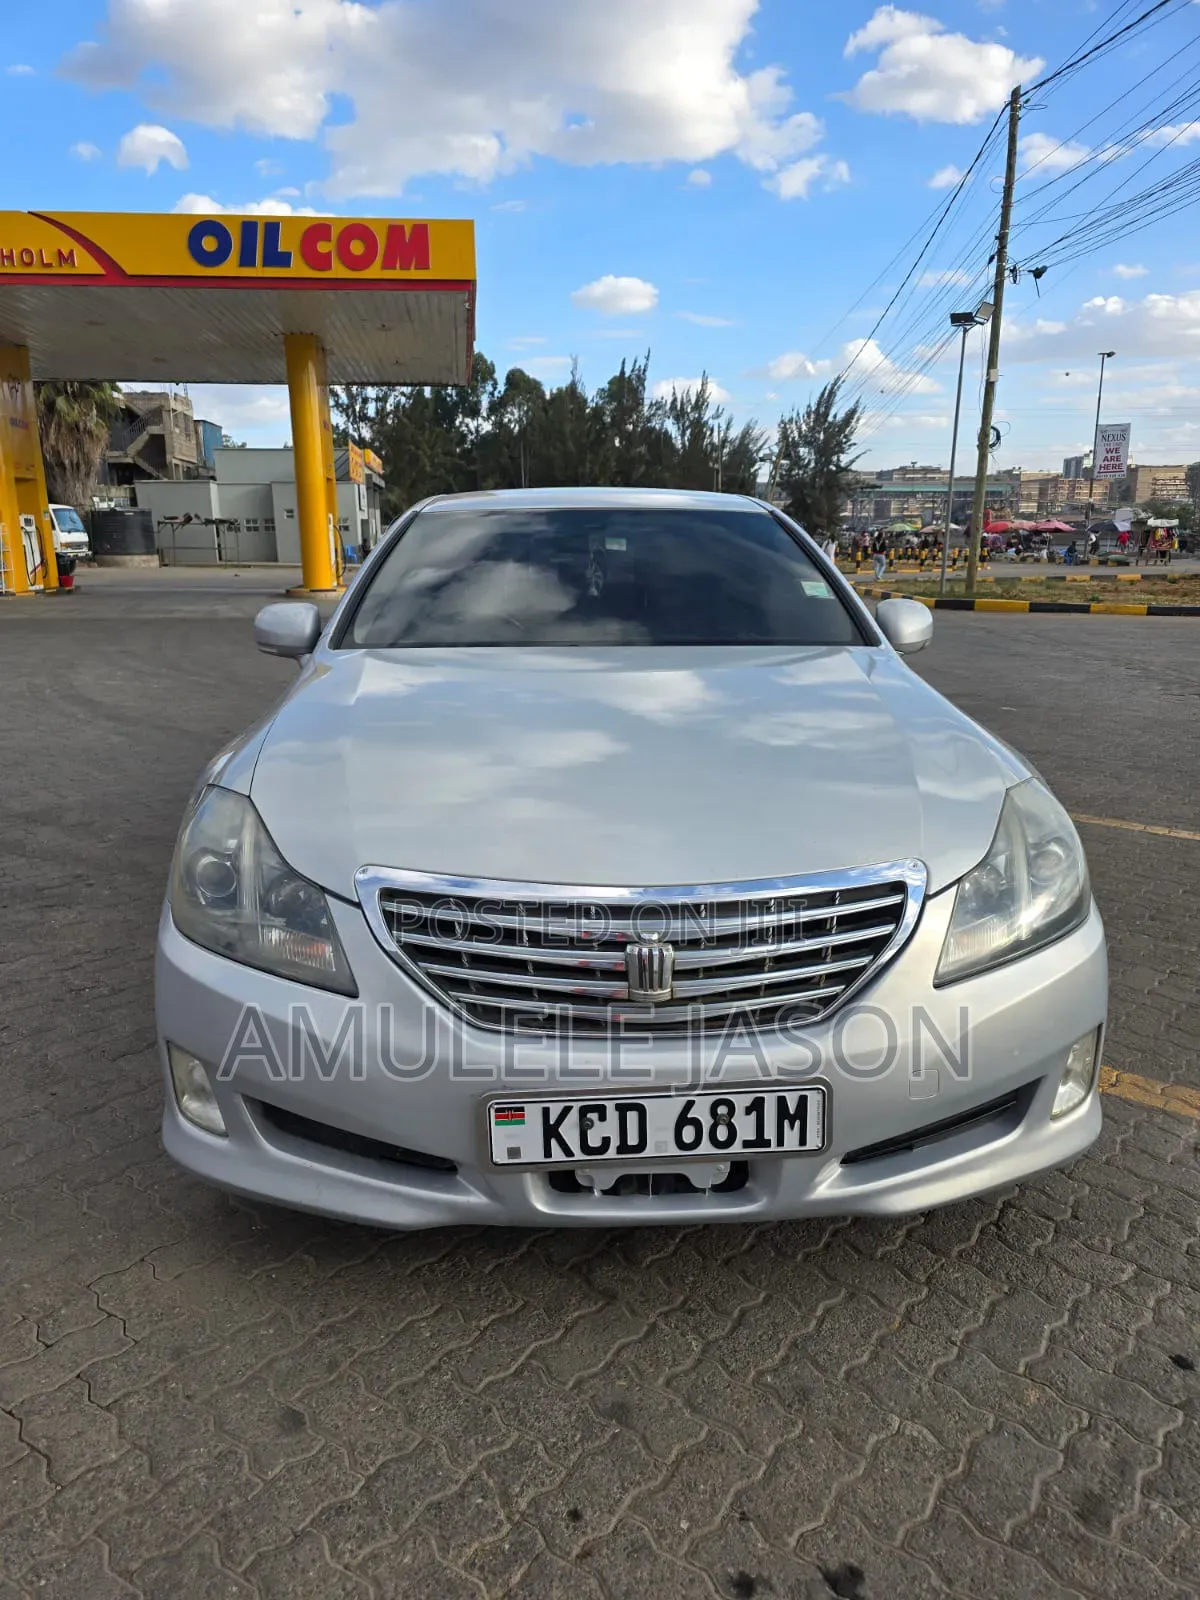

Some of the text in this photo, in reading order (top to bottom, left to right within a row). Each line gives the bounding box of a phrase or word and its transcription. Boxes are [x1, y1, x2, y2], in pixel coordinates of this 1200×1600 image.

[1101, 432, 1127, 442] NEXUS
[542, 1102, 648, 1158] KCD
[674, 1094, 808, 1152] 681M
